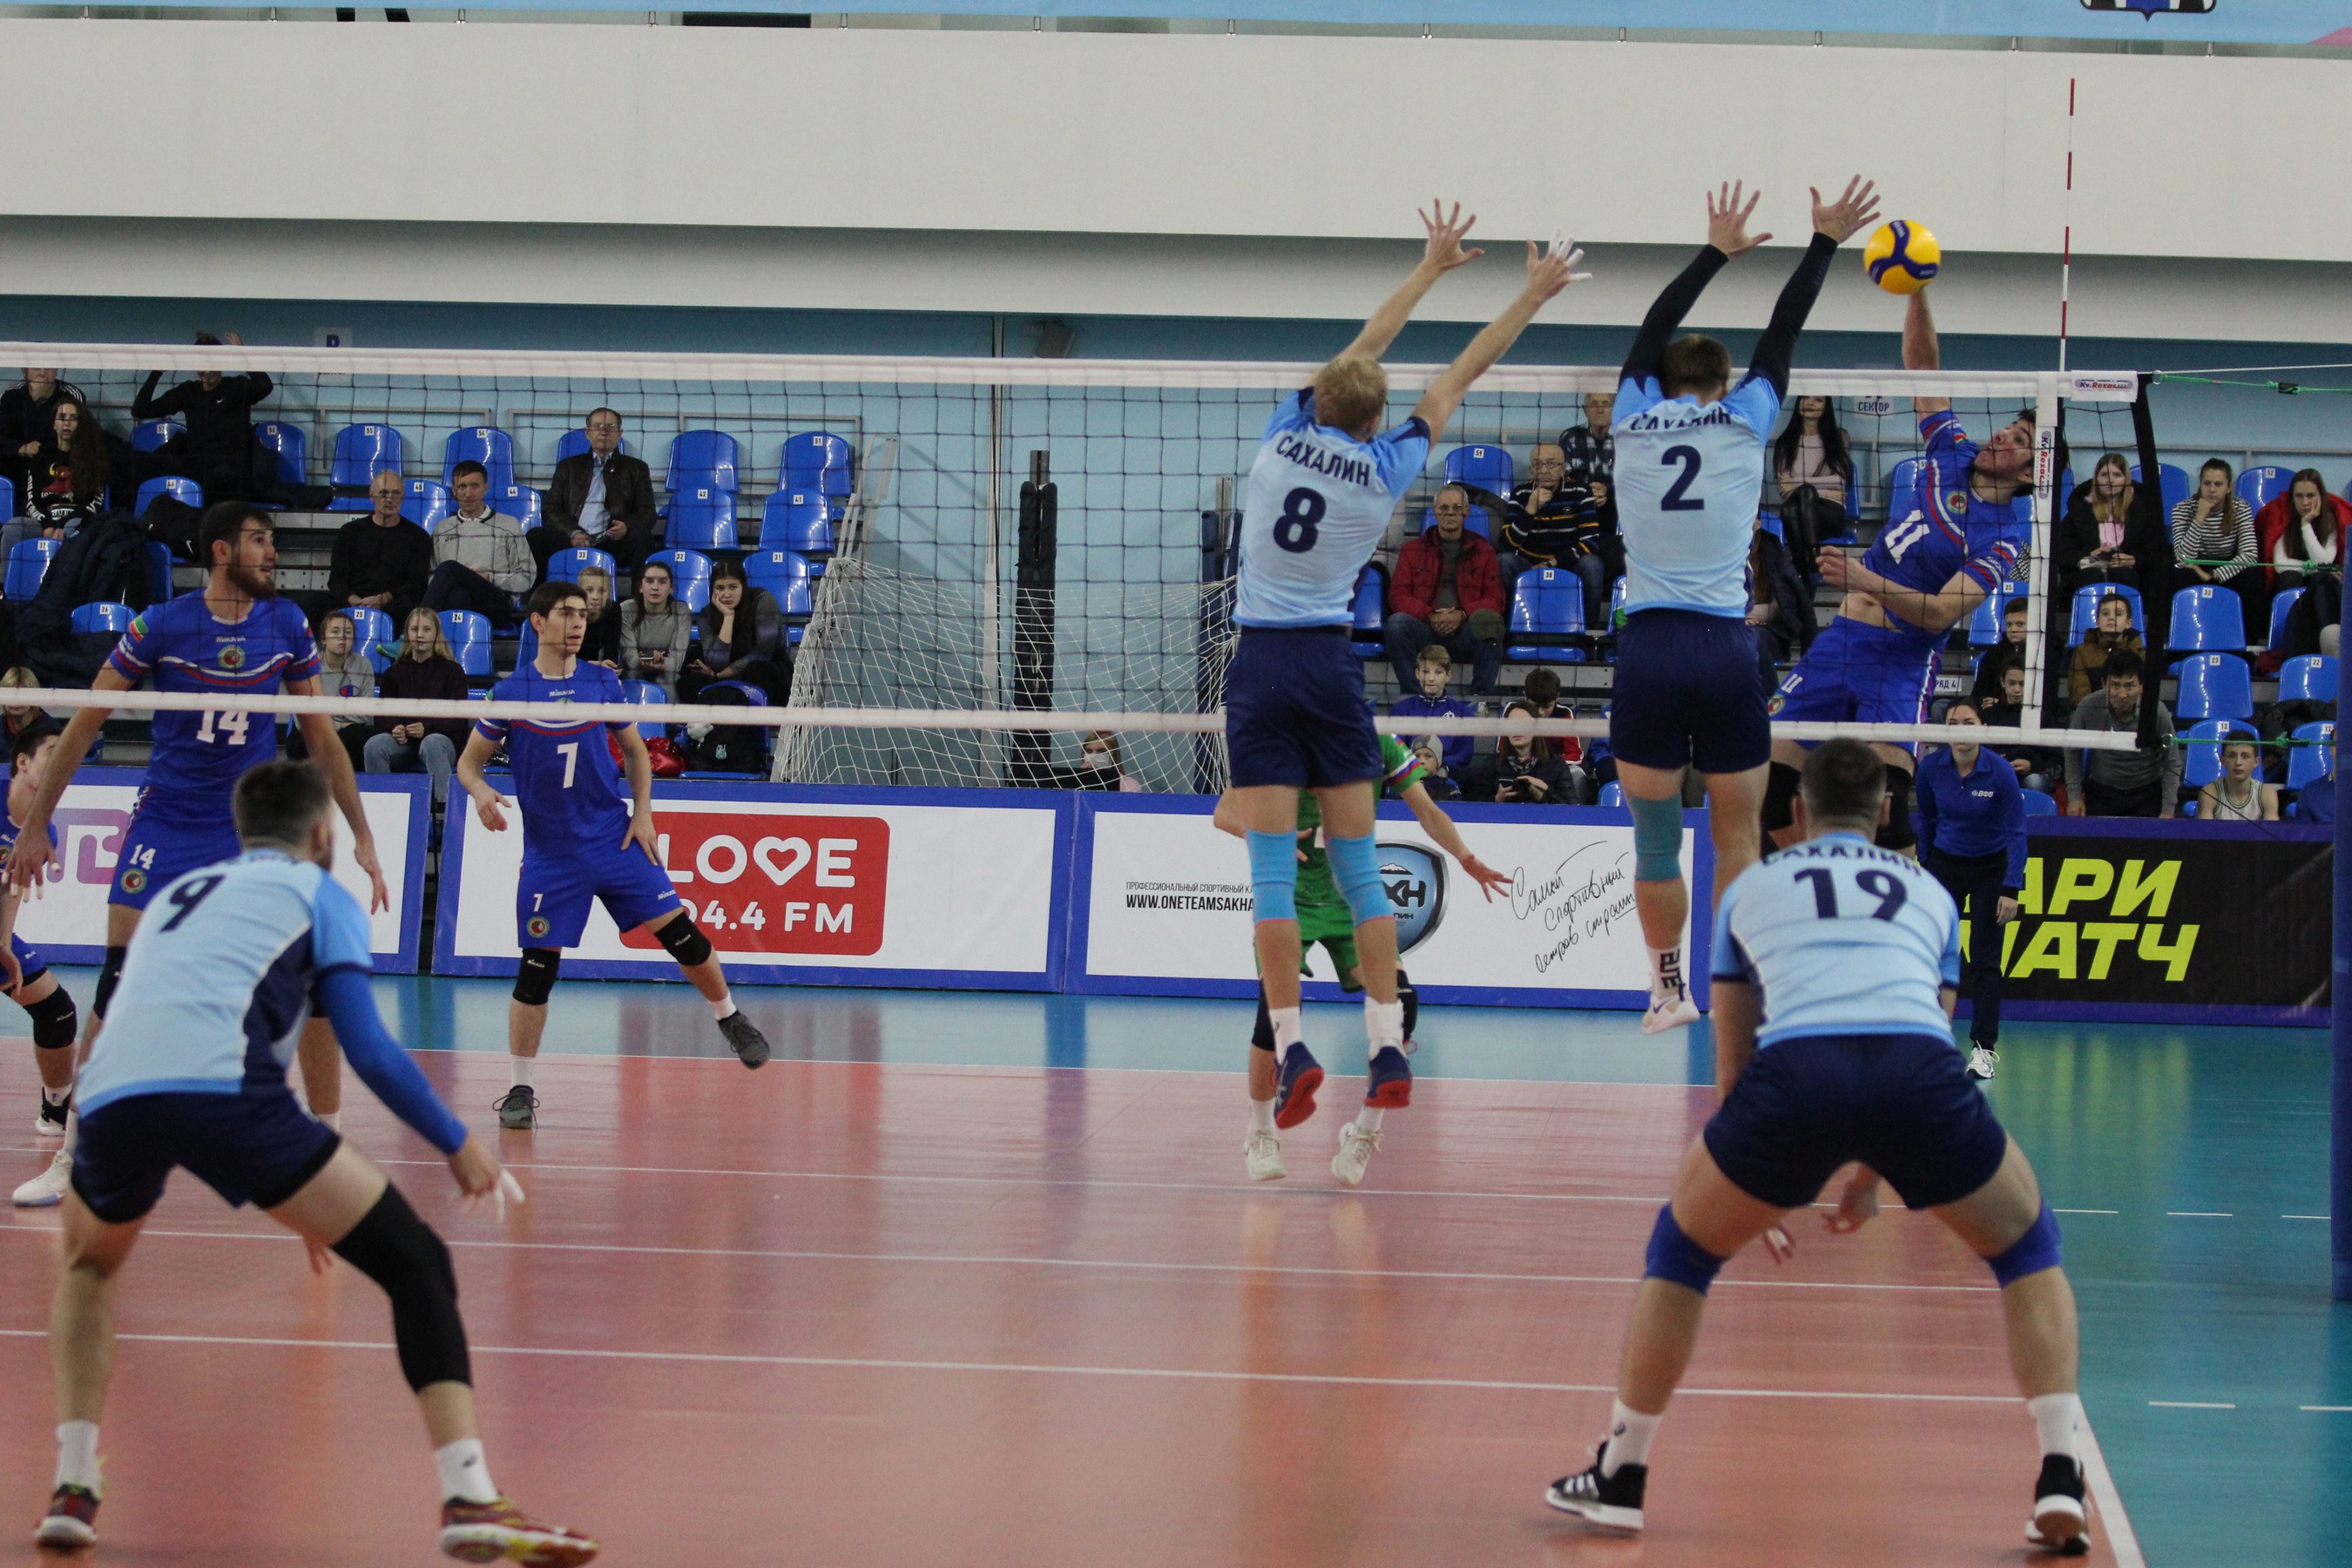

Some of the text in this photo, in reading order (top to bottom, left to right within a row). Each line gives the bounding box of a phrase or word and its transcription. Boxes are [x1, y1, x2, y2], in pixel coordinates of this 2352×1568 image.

[1858, 402, 1889, 412] СЕКТОР
[1276, 436, 1370, 486] САХАЛИН
[1660, 444, 1705, 511] 2
[1273, 486, 1327, 553] 8
[1884, 510, 1930, 564] 11
[197, 710, 250, 746] 14
[557, 742, 579, 789] 7
[129, 843, 157, 870] 14
[159, 874, 226, 934] 9
[532, 893, 544, 912] 7
[1125, 881, 1198, 892] ПРОФЕССИОНАЛЬНЫЙ
[1200, 882, 1244, 894] СПОРТИВНЫЙ
[1126, 894, 1254, 911] WWW.ONETEAMSAKHA
[1794, 867, 1908, 922] 19
[1963, 856, 2182, 917] АРИ
[784, 902, 854, 934] FM
